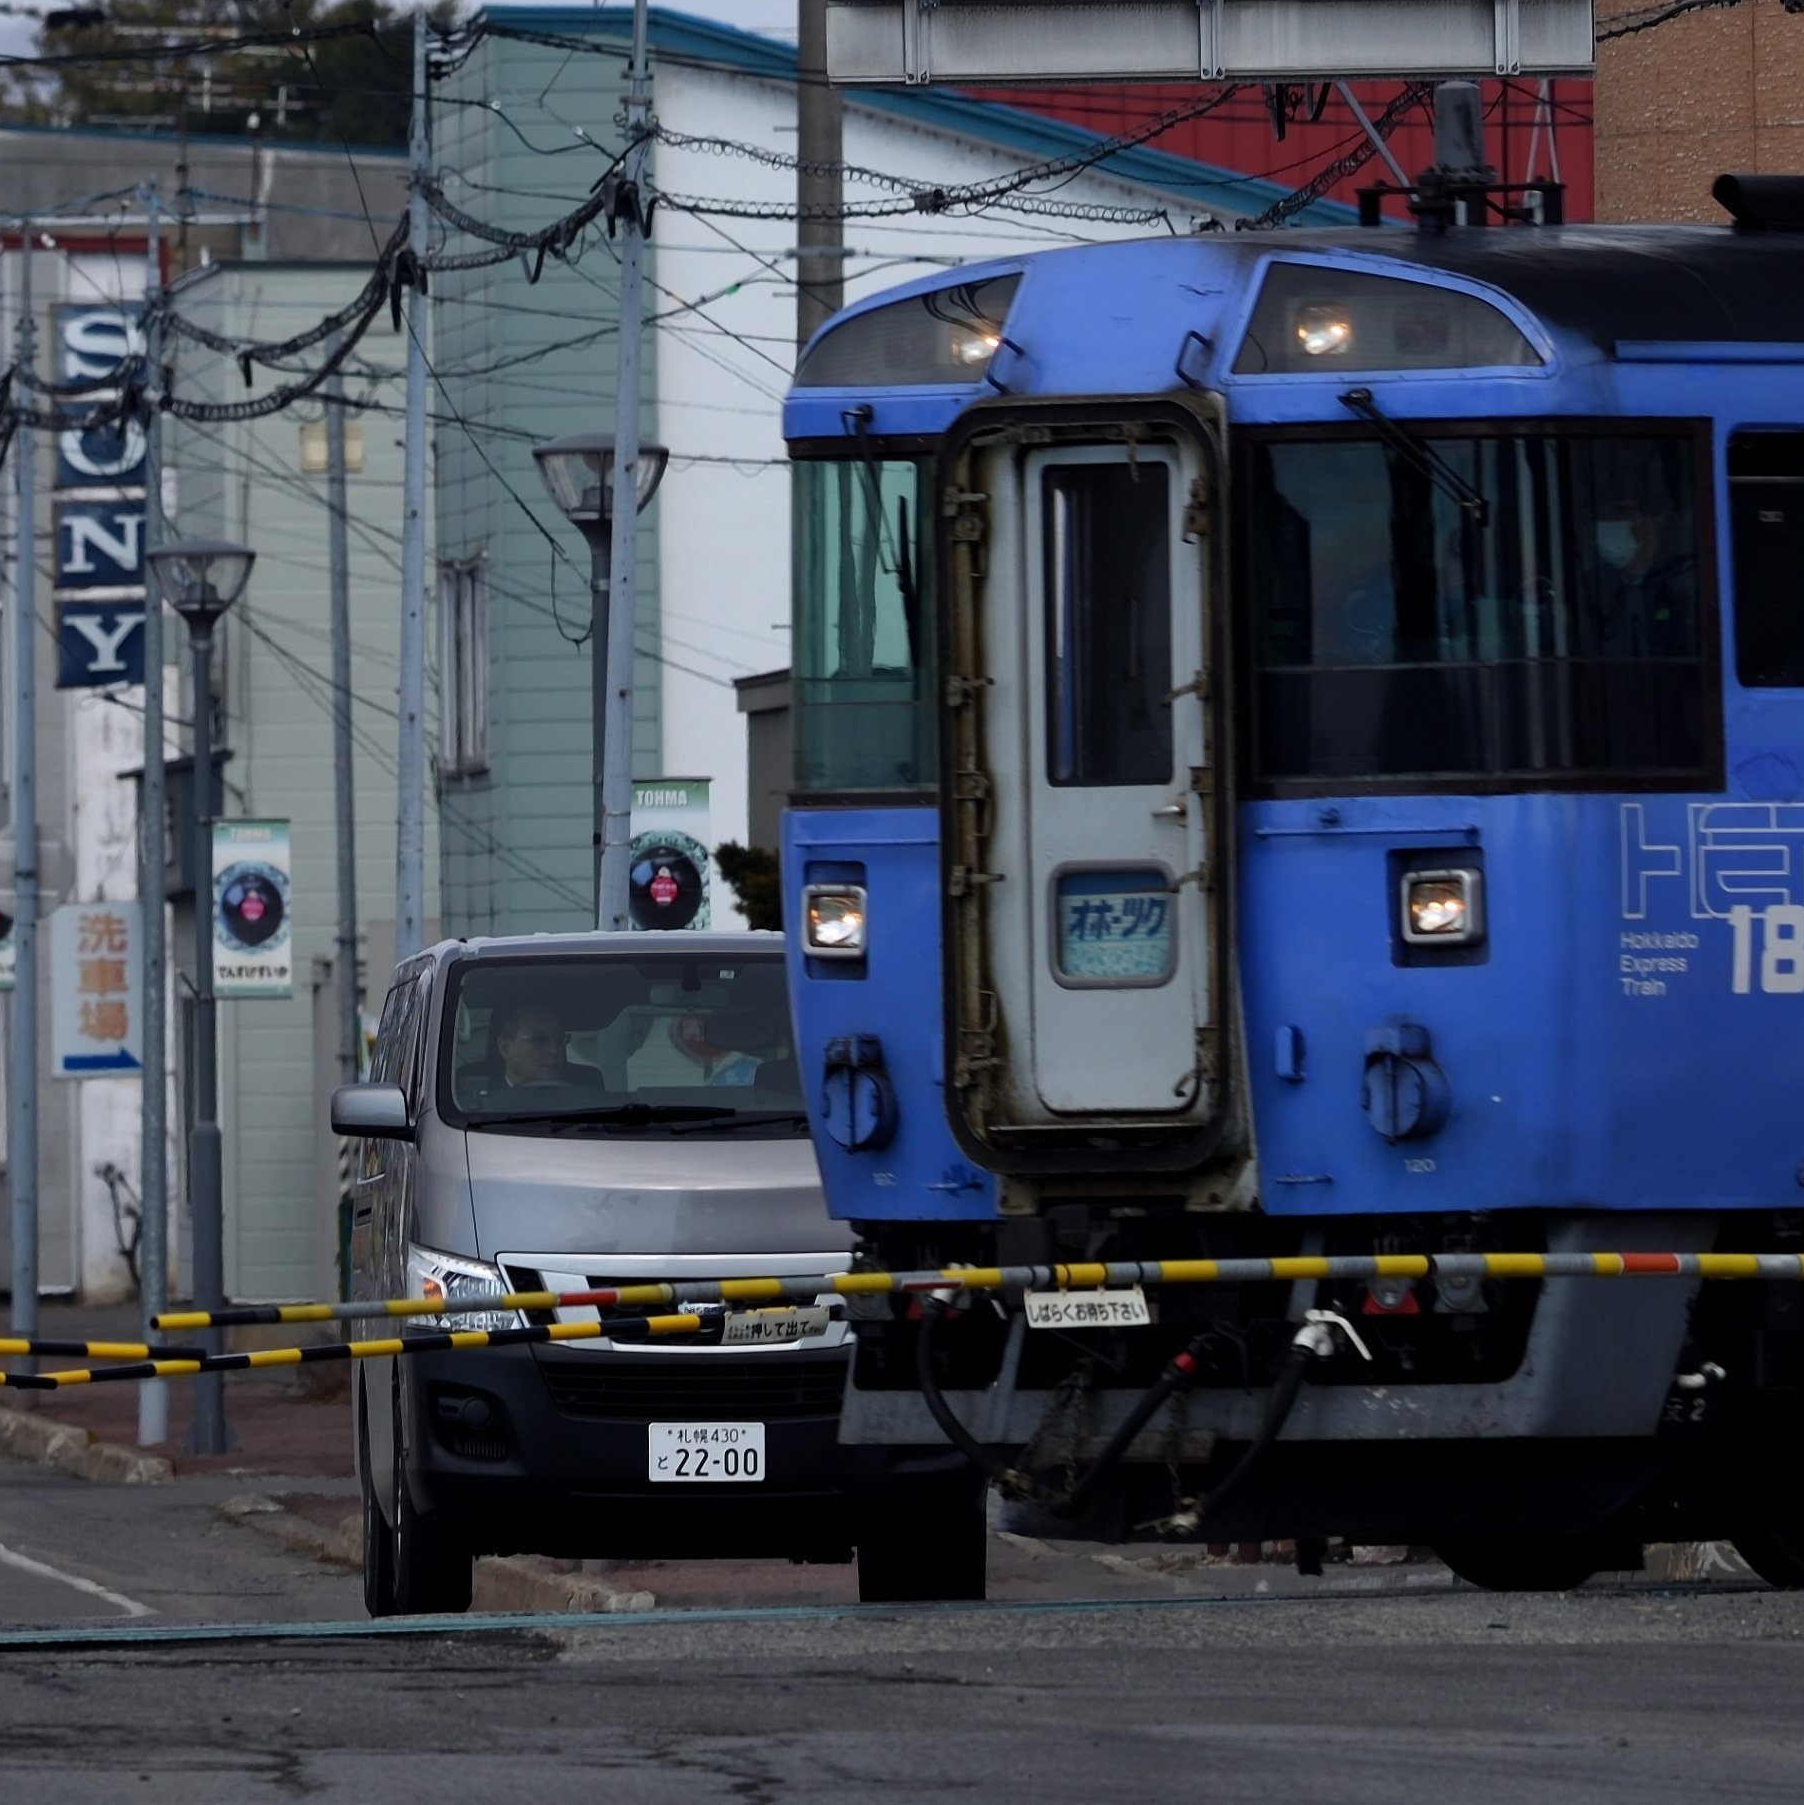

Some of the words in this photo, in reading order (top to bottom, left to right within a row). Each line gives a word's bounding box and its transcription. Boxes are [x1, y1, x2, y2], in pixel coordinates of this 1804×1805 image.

[59, 311, 148, 672] SONY
[635, 789, 689, 806] TOHMA
[1620, 931, 1699, 949] Hokkaido
[1620, 954, 1688, 975] Express
[76, 912, 129, 1041] 洗車場
[1620, 977, 1667, 995] Train
[1028, 1302, 1146, 1323] しばらくお待ち下さい
[657, 1455, 669, 1470] と
[674, 1447, 759, 1477] 22-00
